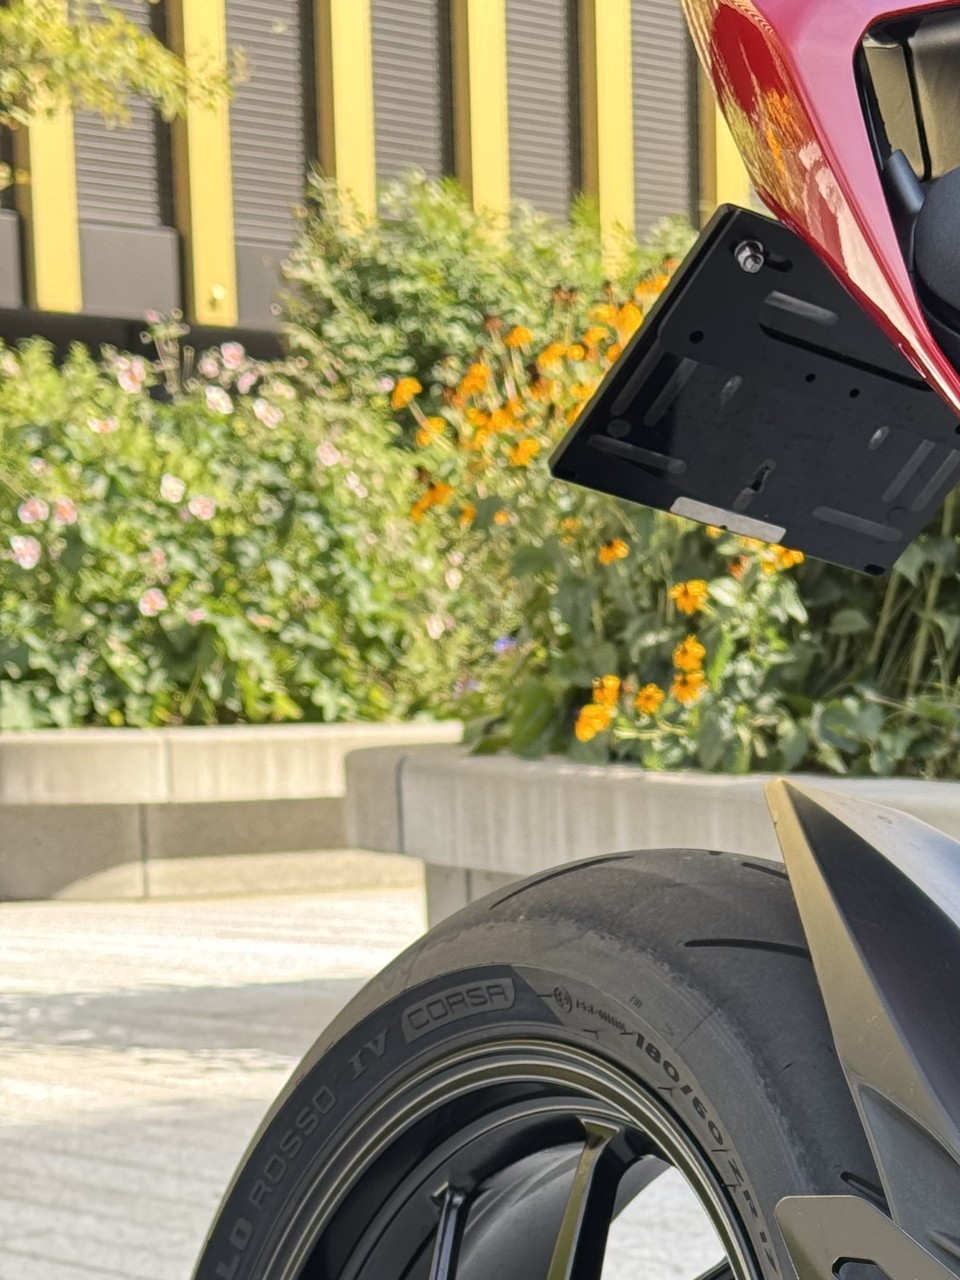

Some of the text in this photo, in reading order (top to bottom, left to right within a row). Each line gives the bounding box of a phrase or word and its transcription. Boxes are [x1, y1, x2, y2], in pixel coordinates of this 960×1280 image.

[250, 1084, 336, 1211] ROSSO
[348, 1027, 390, 1080] IV
[406, 983, 509, 1031] CORSA
